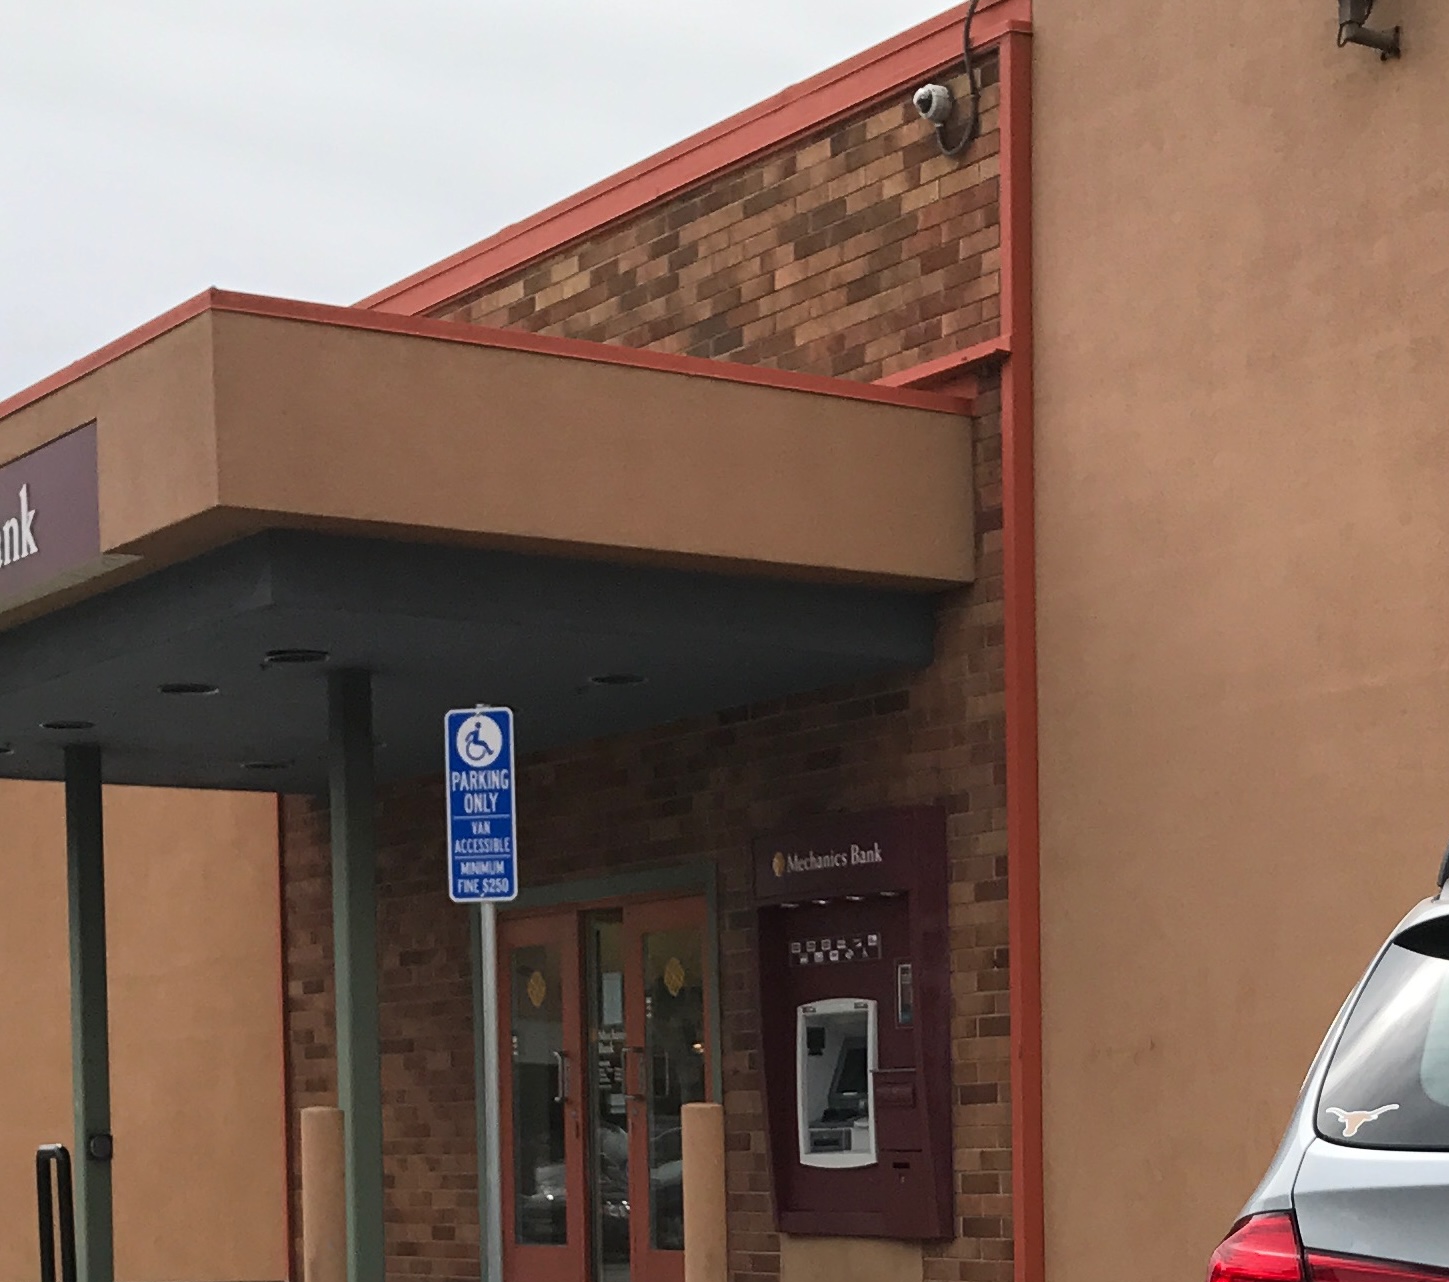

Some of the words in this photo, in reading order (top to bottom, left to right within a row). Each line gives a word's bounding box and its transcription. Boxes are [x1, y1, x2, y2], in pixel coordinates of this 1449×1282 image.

[452, 768, 510, 792] PARKING
[463, 792, 499, 814] ONLY
[471, 821, 490, 835] VAN
[454, 837, 510, 854] ACCESSIBLE
[787, 850, 848, 873] Mechanics
[850, 842, 882, 865] Bank
[460, 861, 504, 875] MINIMUM
[457, 879, 479, 894] FINE
[482, 877, 509, 894] $250
